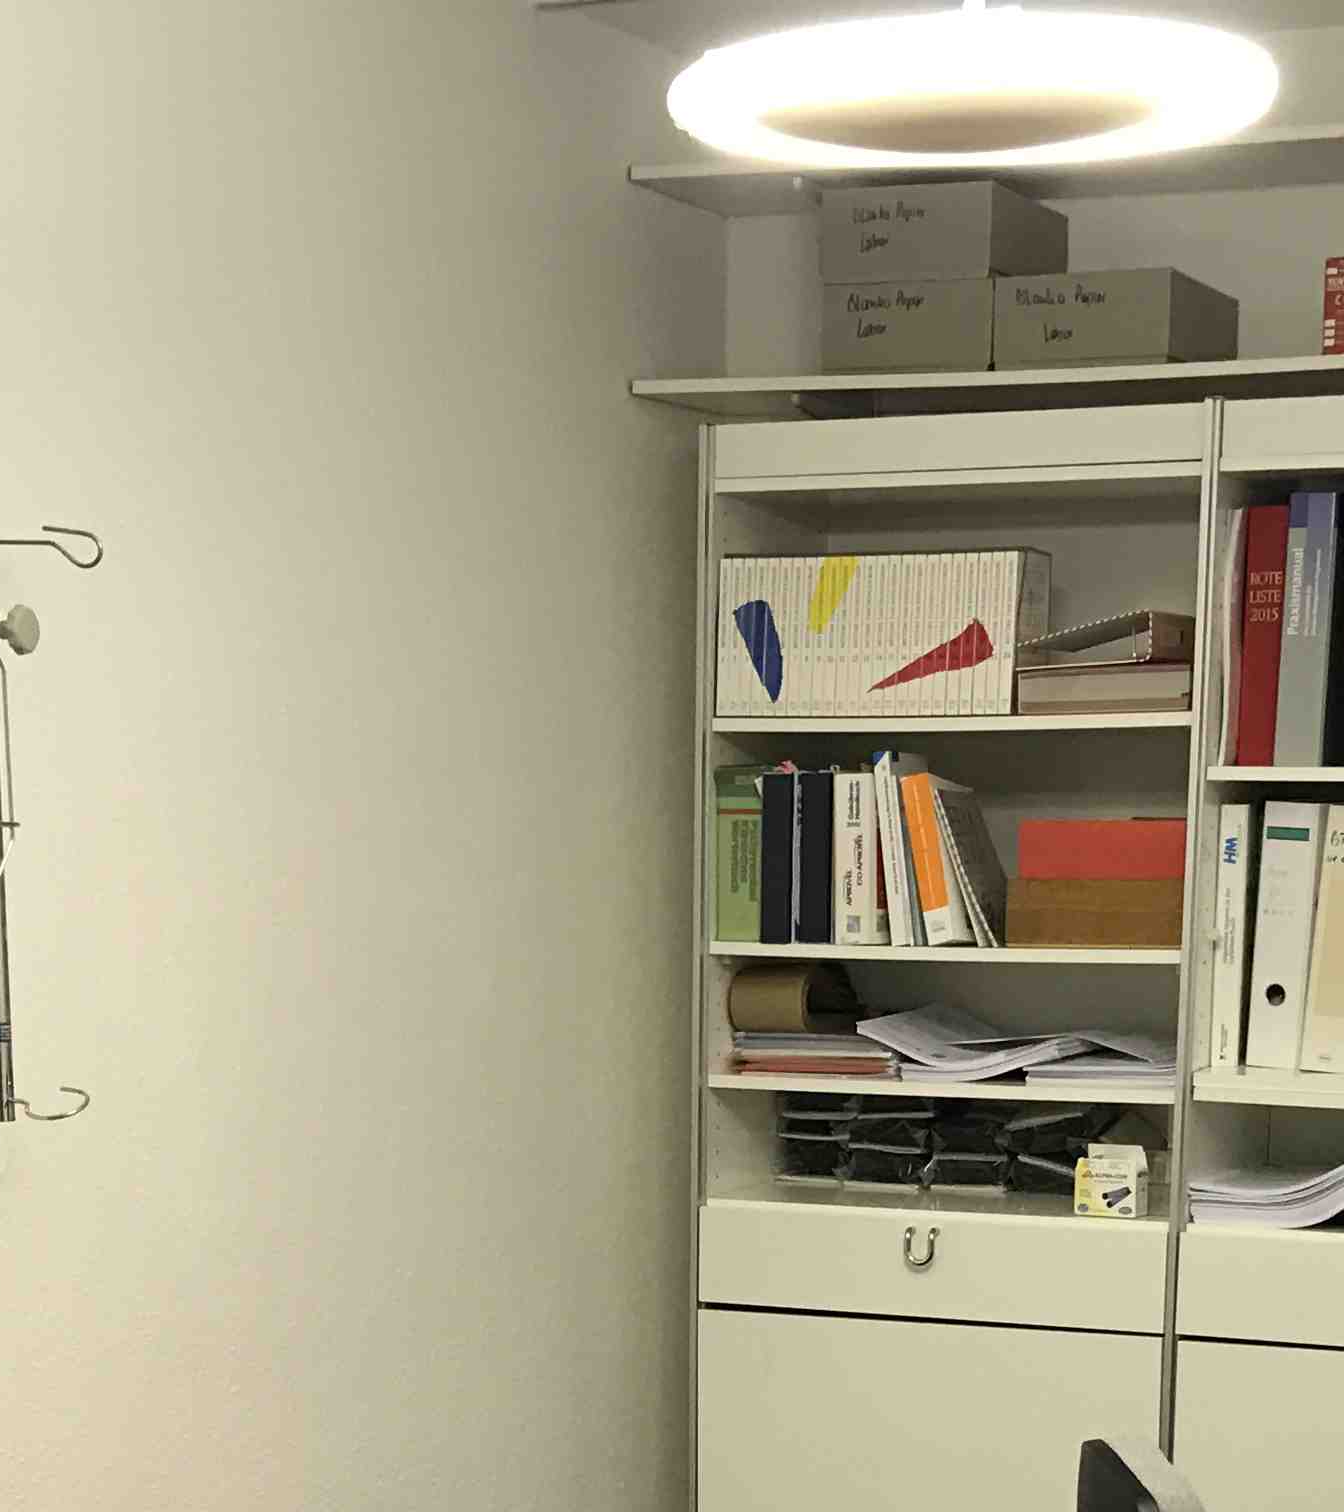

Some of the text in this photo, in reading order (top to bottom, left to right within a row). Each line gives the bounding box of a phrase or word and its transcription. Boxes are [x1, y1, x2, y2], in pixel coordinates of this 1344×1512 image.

[1250, 571, 1283, 585] ROTE
[1249, 590, 1281, 604] LISTE
[1250, 608, 1280, 622] 2015
